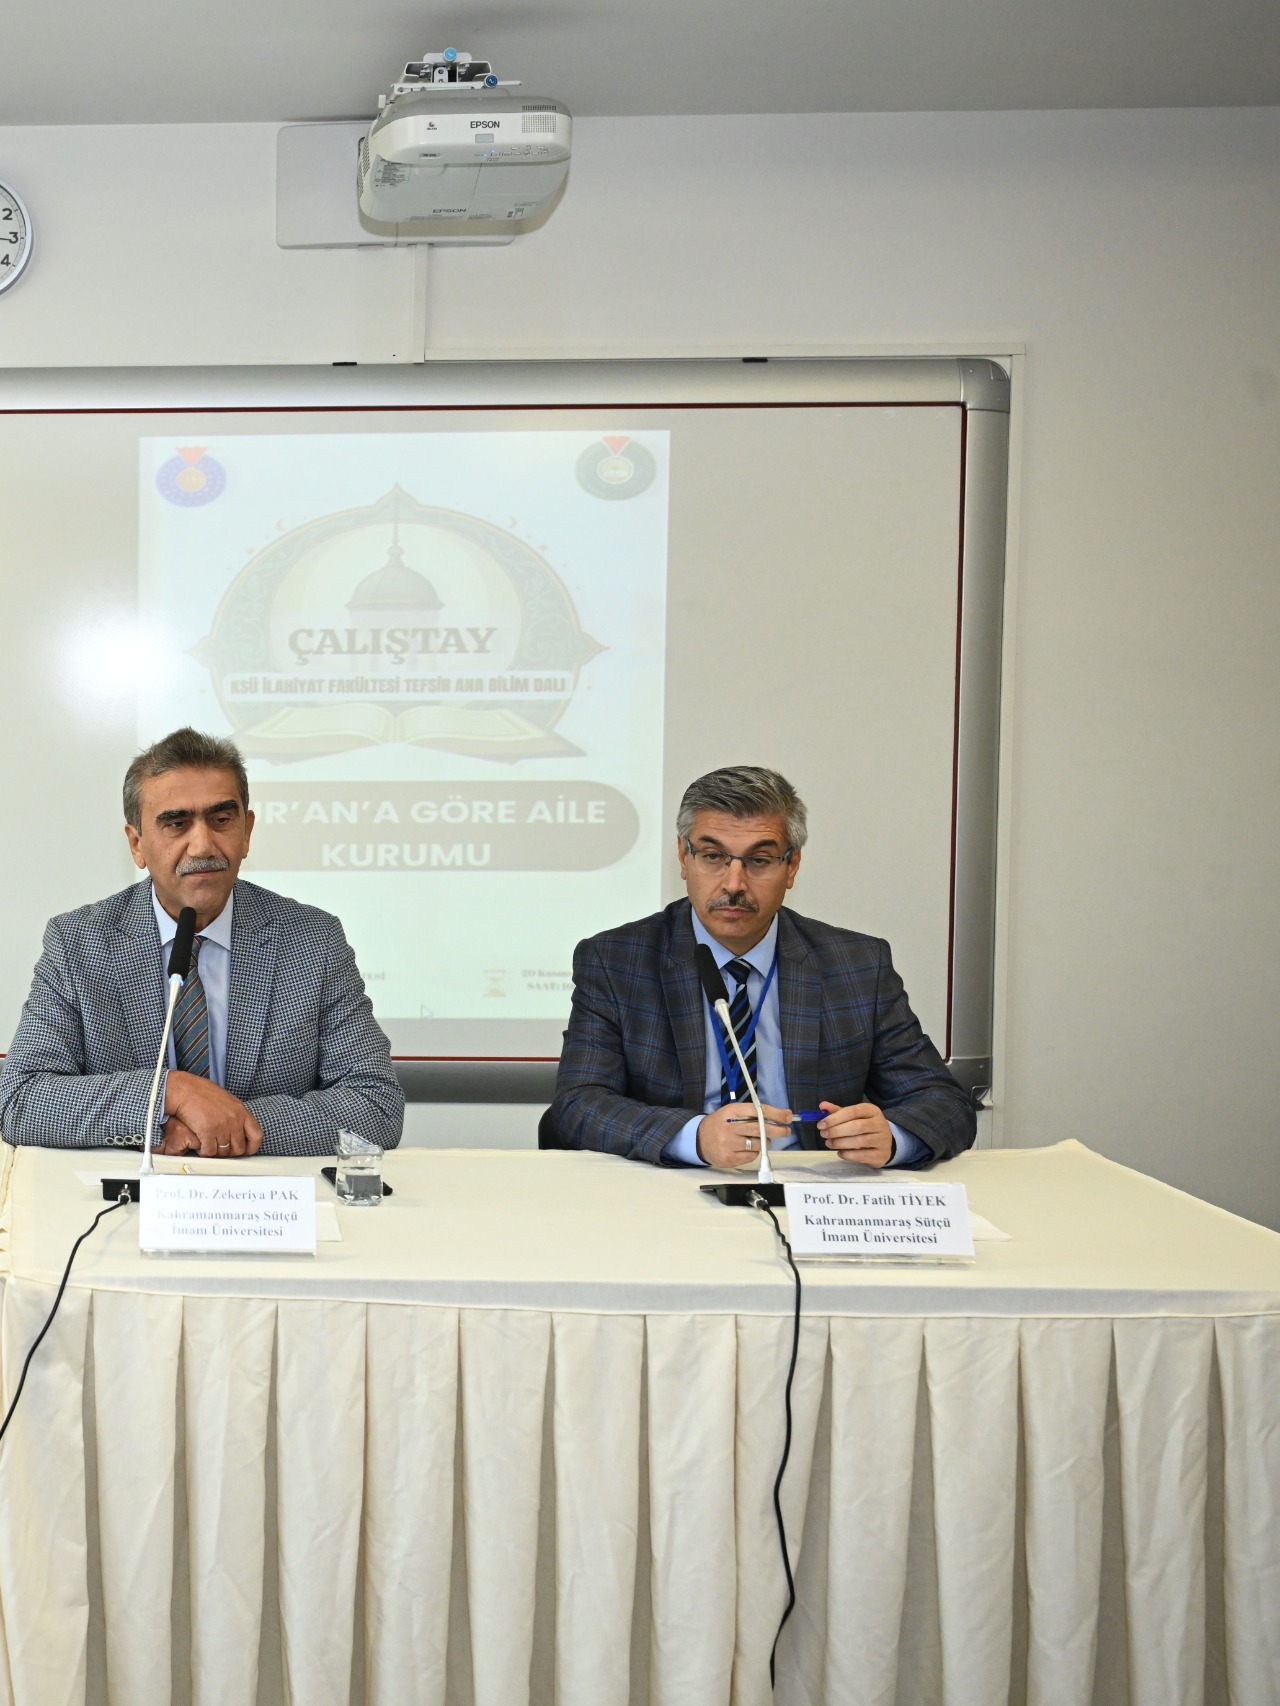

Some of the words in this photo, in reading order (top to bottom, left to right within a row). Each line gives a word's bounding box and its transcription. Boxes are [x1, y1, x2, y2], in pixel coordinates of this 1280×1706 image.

[470, 121, 500, 129] EPSON
[2, 208, 13, 220] 2
[8, 231, 19, 244] 3
[0, 254, 11, 267] 4
[288, 627, 497, 665] ÇALIŞTAY
[231, 677, 258, 694] KSÜ
[262, 676, 324, 694] İLAHİYAT
[328, 675, 400, 693] FAKÜLTESİ
[404, 675, 450, 693] TEFSİR
[455, 678, 484, 693] ANA
[488, 675, 529, 693] BİLİM
[533, 678, 566, 693] DALI
[410, 795, 516, 824] GÖRE
[525, 795, 606, 824] AİLE
[322, 843, 491, 868] KURUMU
[156, 1188, 185, 1199] Prof.
[189, 1189, 208, 1199] Dr.
[212, 1189, 266, 1203] Zekeriya
[270, 1190, 299, 1201] PAK
[803, 1193, 834, 1204] Prof.
[838, 1194, 858, 1205] Dr.
[862, 1194, 896, 1206] Fatih
[898, 1193, 947, 1207] TİYEK
[157, 1209, 260, 1222] Kahramanmaraş
[263, 1209, 298, 1223] Sütçü
[804, 1214, 911, 1229] Kahramanmaraş
[915, 1216, 951, 1230] Sütçü
[172, 1223, 207, 1235] İmam
[212, 1223, 284, 1237] Üniversitesi
[821, 1228, 859, 1242] İmam
[863, 1230, 938, 1244] Üniversitesi
